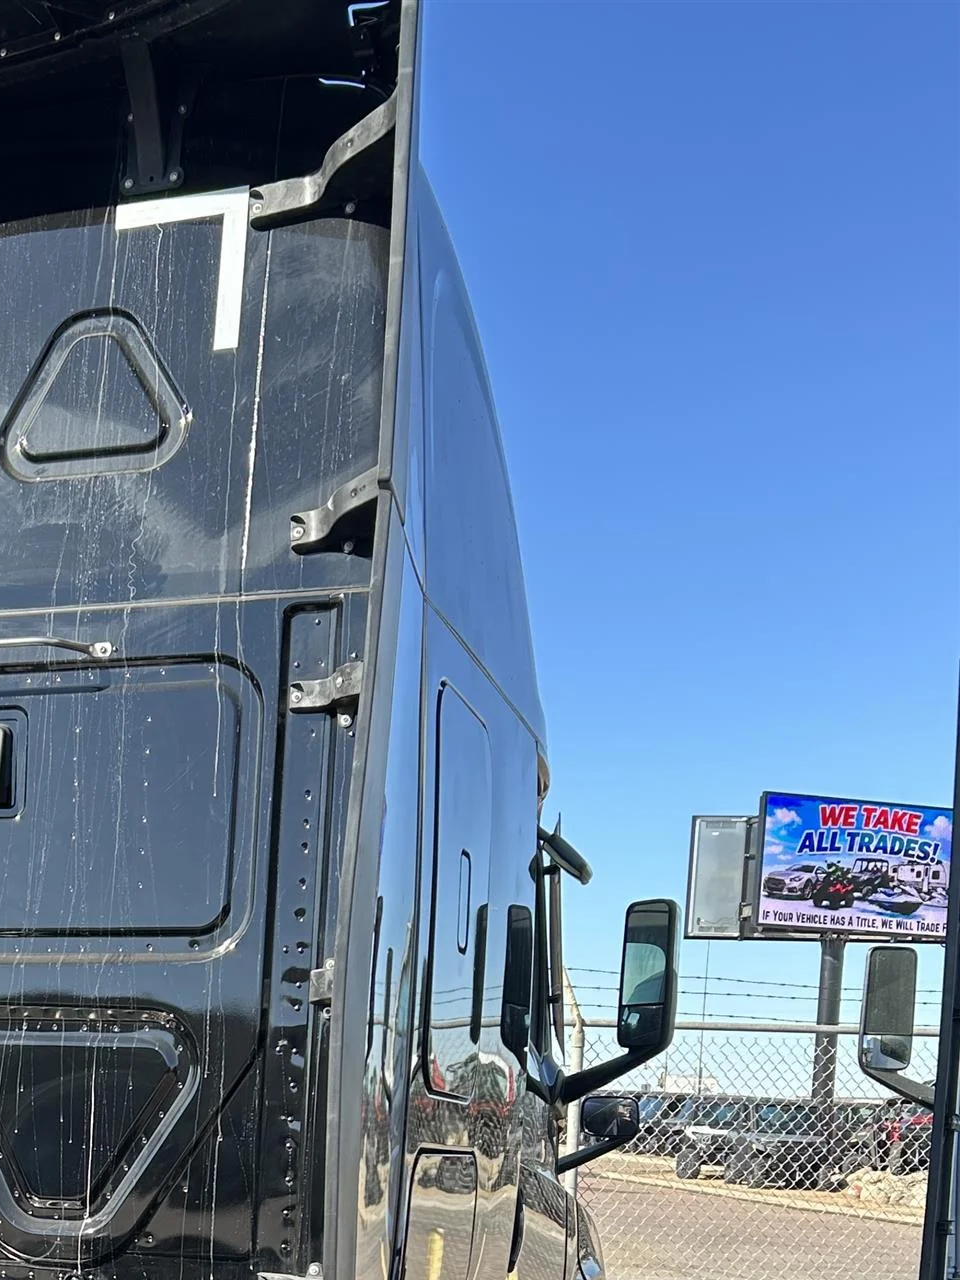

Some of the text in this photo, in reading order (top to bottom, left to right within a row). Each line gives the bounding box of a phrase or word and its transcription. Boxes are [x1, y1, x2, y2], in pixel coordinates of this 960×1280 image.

[820, 805, 922, 834] WE TAKE
[797, 831, 941, 863] ALL TRADES!
[762, 909, 770, 920] IF
[773, 910, 794, 922] YOUR
[796, 912, 828, 925] VEHICLE
[830, 914, 846, 926] HAS
[847, 916, 853, 927] A
[856, 916, 879, 929] TITLE,
[881, 918, 893, 930] WE
[895, 919, 914, 931] WILL
[916, 920, 941, 933] TRADE
